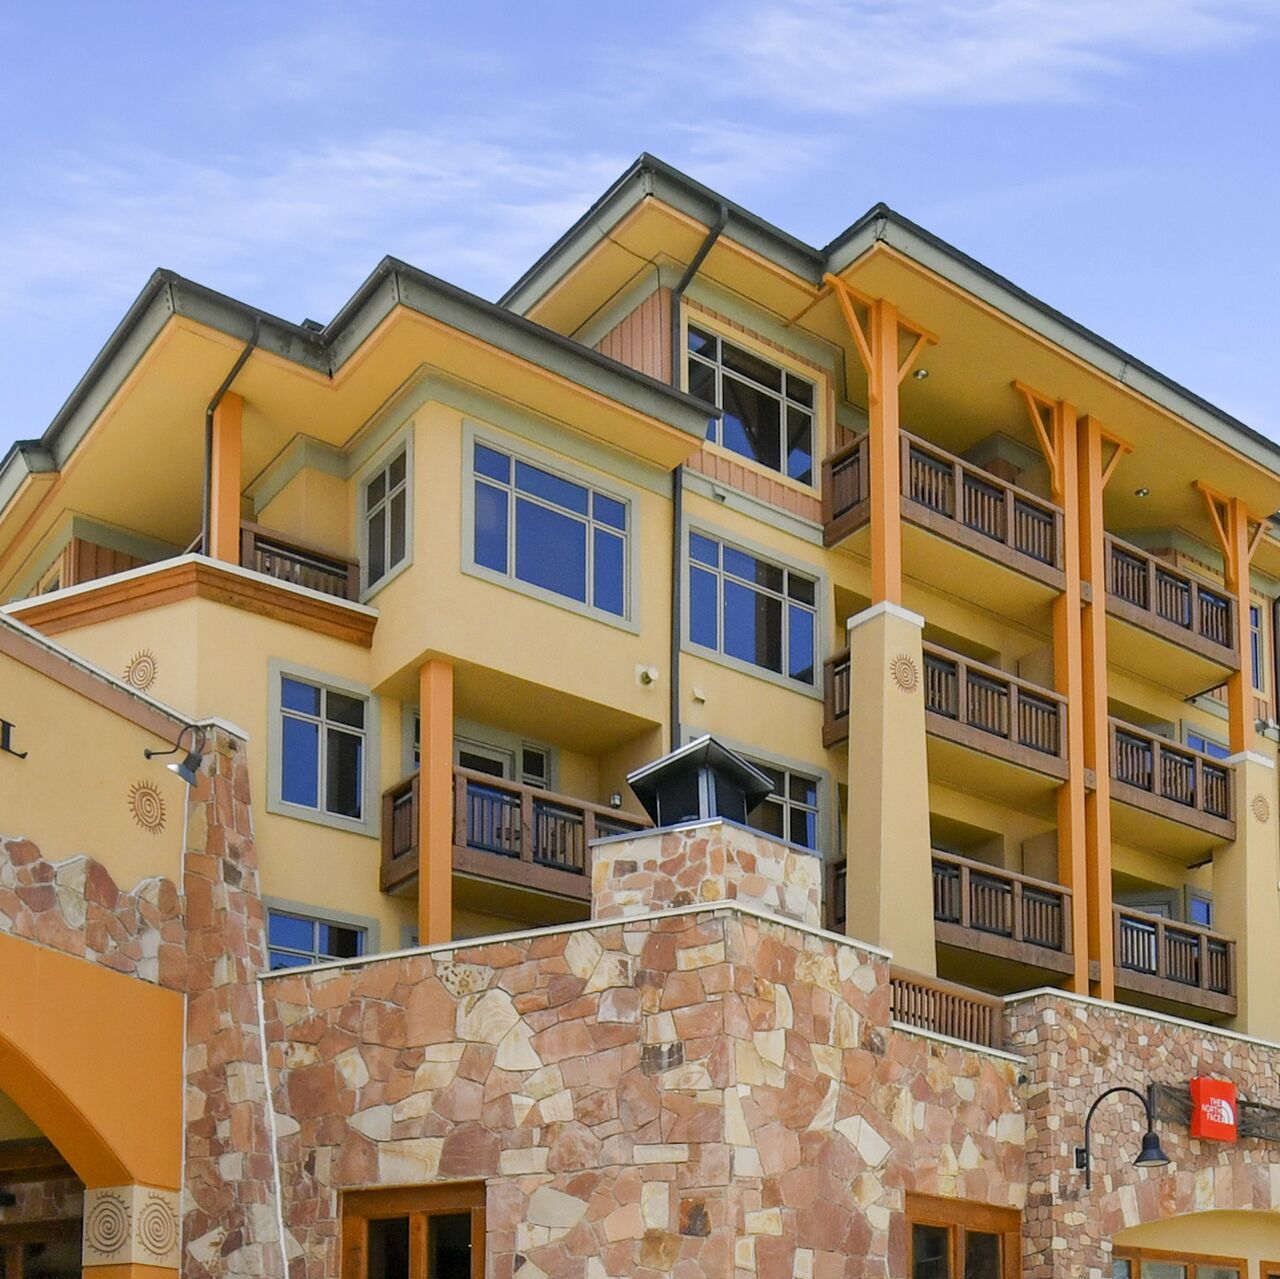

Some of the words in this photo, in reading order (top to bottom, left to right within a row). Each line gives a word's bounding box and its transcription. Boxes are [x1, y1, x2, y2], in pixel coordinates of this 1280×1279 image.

[1210, 1098, 1222, 1107] THE
[1202, 1104, 1222, 1114] NORTH
[1207, 1113, 1222, 1123] FACE
